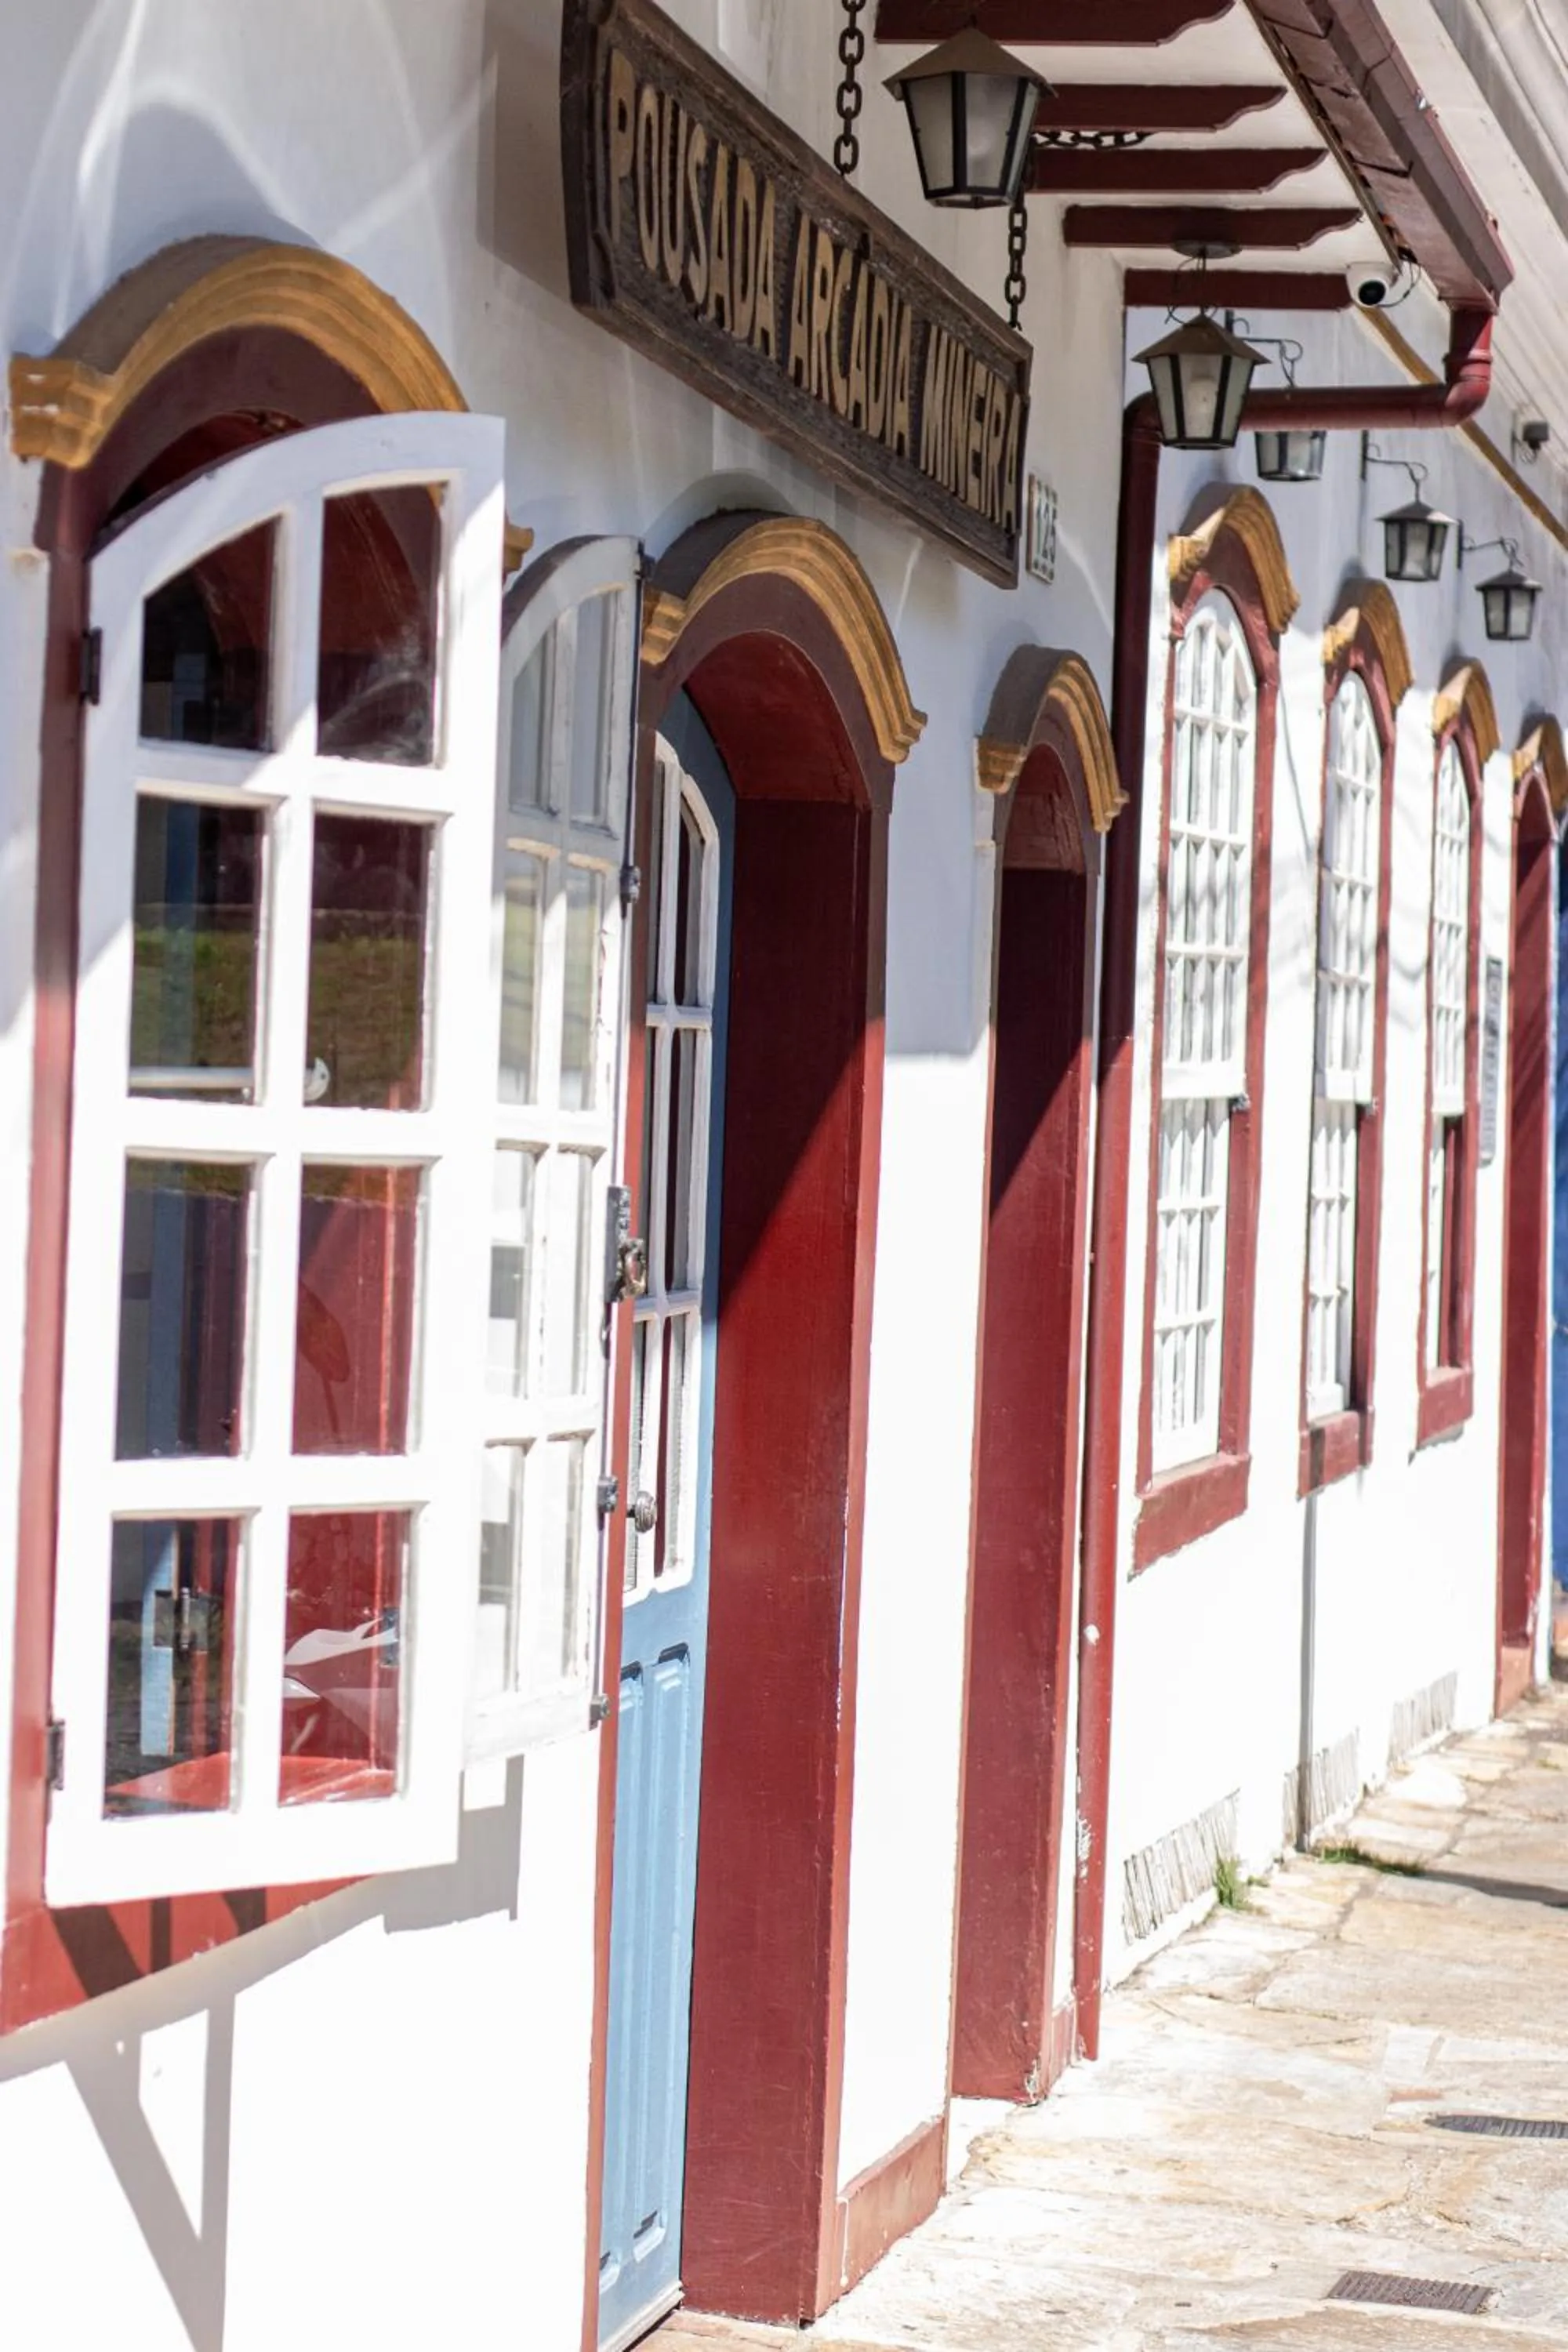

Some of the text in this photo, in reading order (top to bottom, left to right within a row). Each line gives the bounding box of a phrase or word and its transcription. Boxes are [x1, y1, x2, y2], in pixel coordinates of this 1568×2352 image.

[609, 49, 1018, 535] POUSADA ARCADIA MINEIRA
